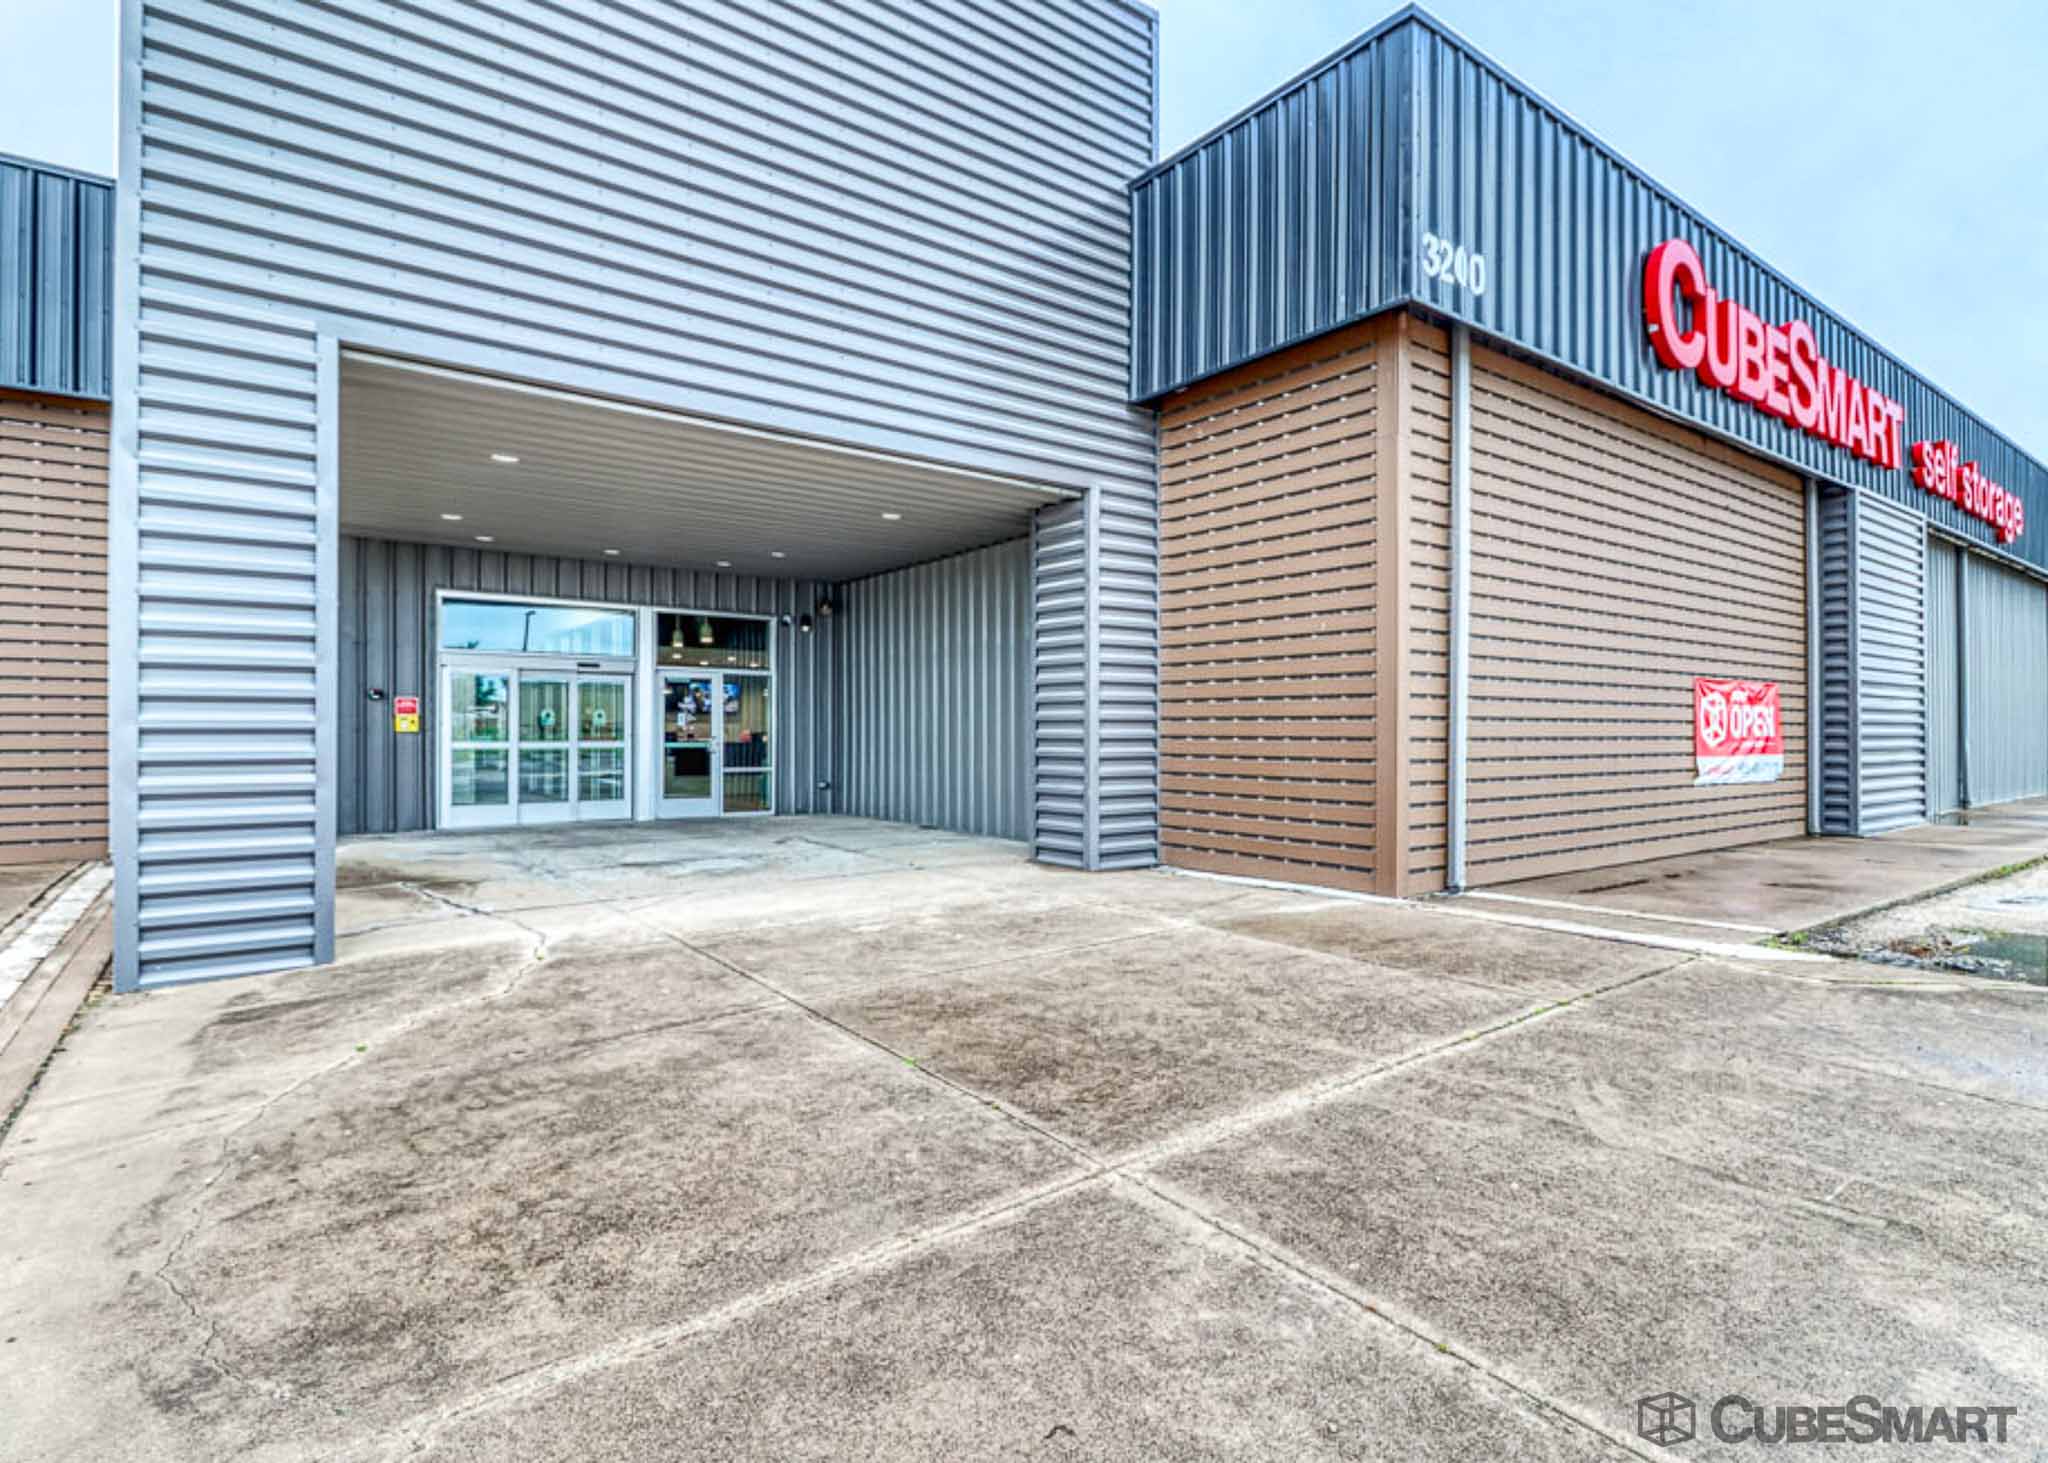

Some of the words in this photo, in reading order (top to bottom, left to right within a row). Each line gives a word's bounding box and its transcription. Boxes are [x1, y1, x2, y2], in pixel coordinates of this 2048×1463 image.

[1422, 231, 1486, 296] 3200
[1645, 238, 1904, 470] CUBESMART
[1912, 439, 1958, 501] self
[1958, 460, 2024, 544] storage
